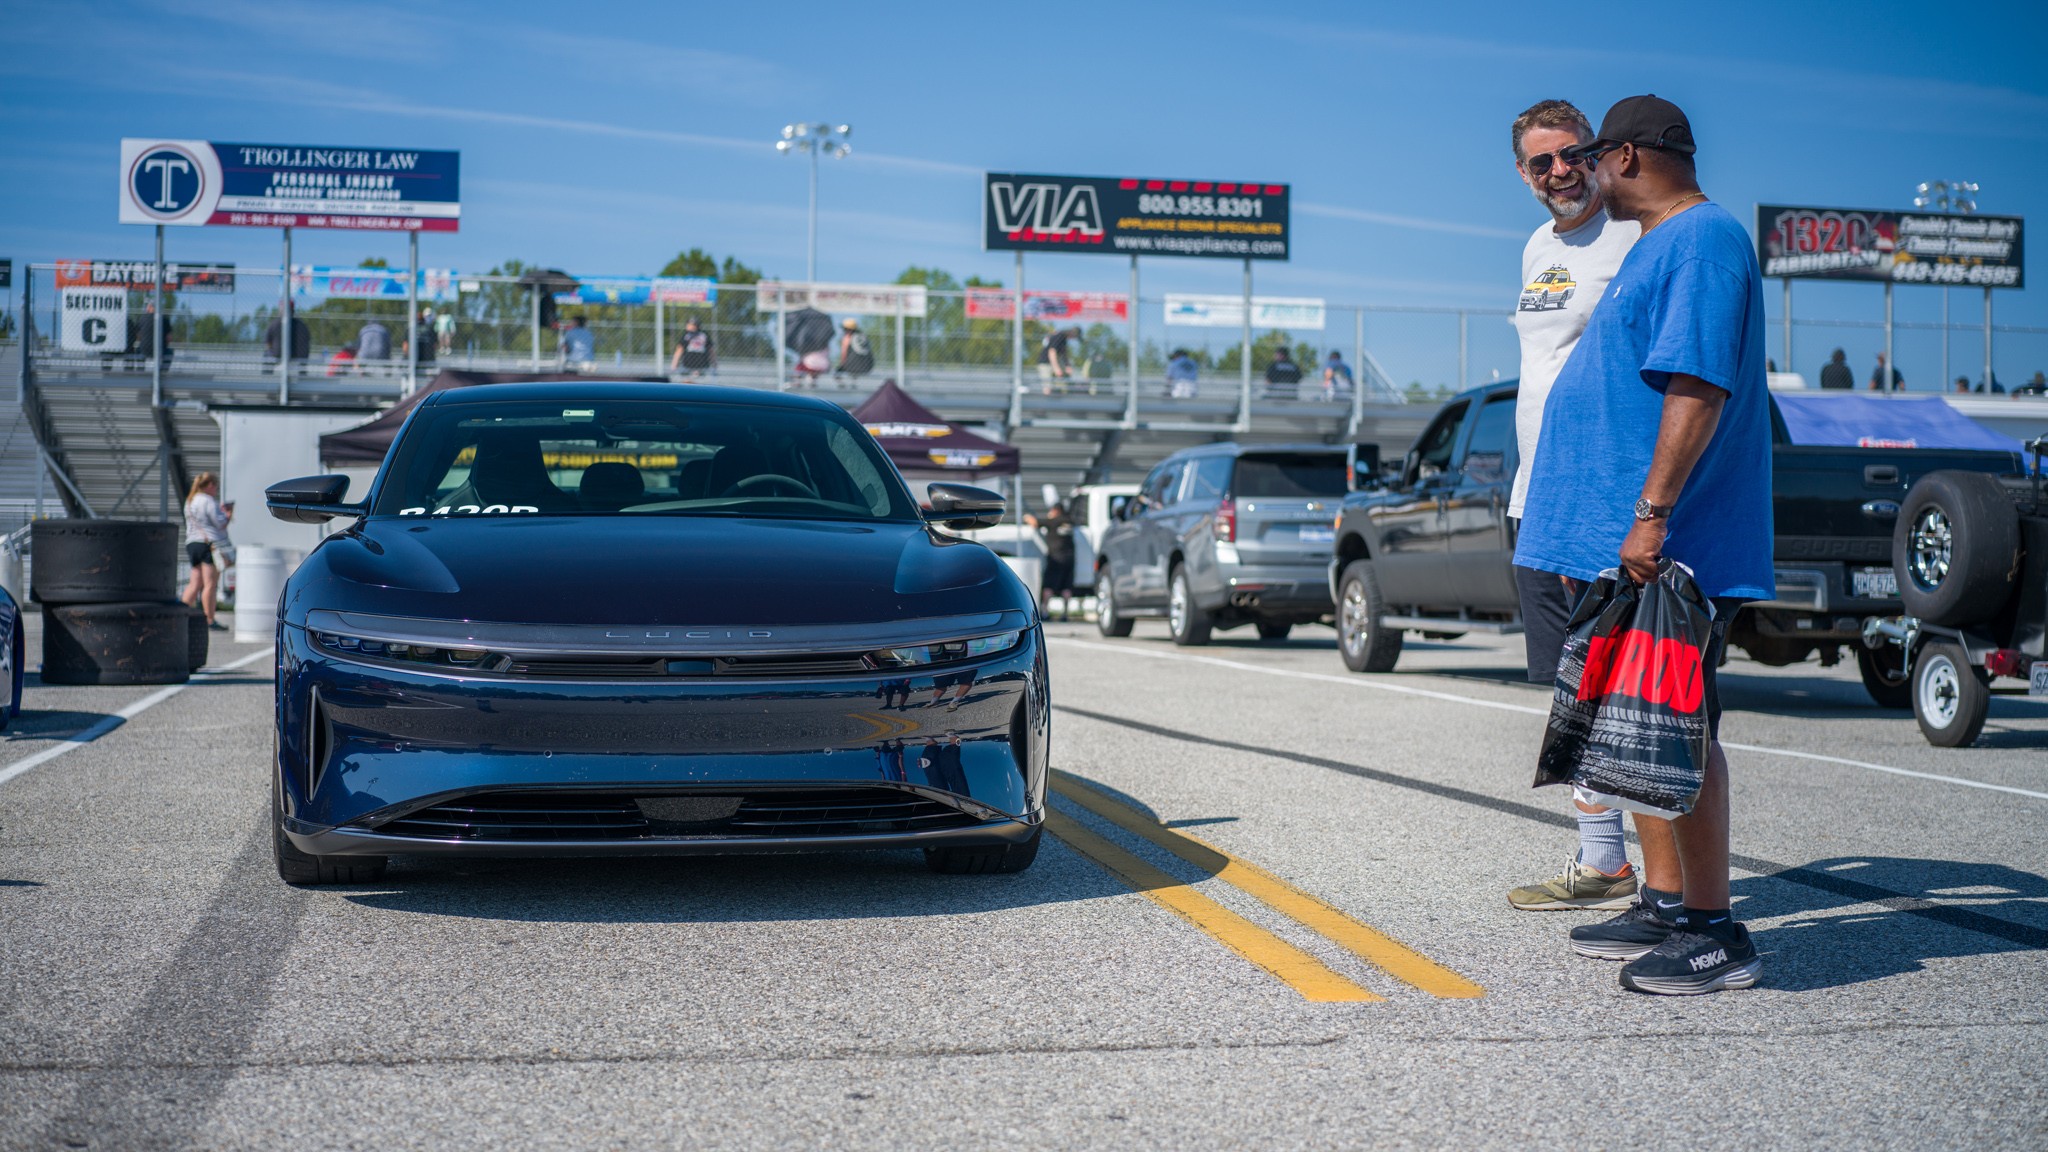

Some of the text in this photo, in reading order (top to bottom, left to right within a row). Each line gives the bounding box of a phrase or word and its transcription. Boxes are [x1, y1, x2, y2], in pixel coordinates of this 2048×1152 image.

[240, 147, 419, 170] TROLLINGER LAW
[145, 158, 190, 209] T
[272, 171, 395, 190] PERSONAL INJURY
[990, 181, 1105, 235] VIA
[1138, 193, 1263, 218] 800.955.8301
[1117, 217, 1283, 235] APPLIANCE REPAIR SPECIALISTS
[1113, 234, 1286, 255] www.viaappliance.com
[93, 261, 179, 284] BAYSIE
[66, 293, 123, 310] SECTION
[82, 318, 107, 345] C
[605, 630, 772, 638] LUCID
[1689, 948, 1728, 972] HOKA
